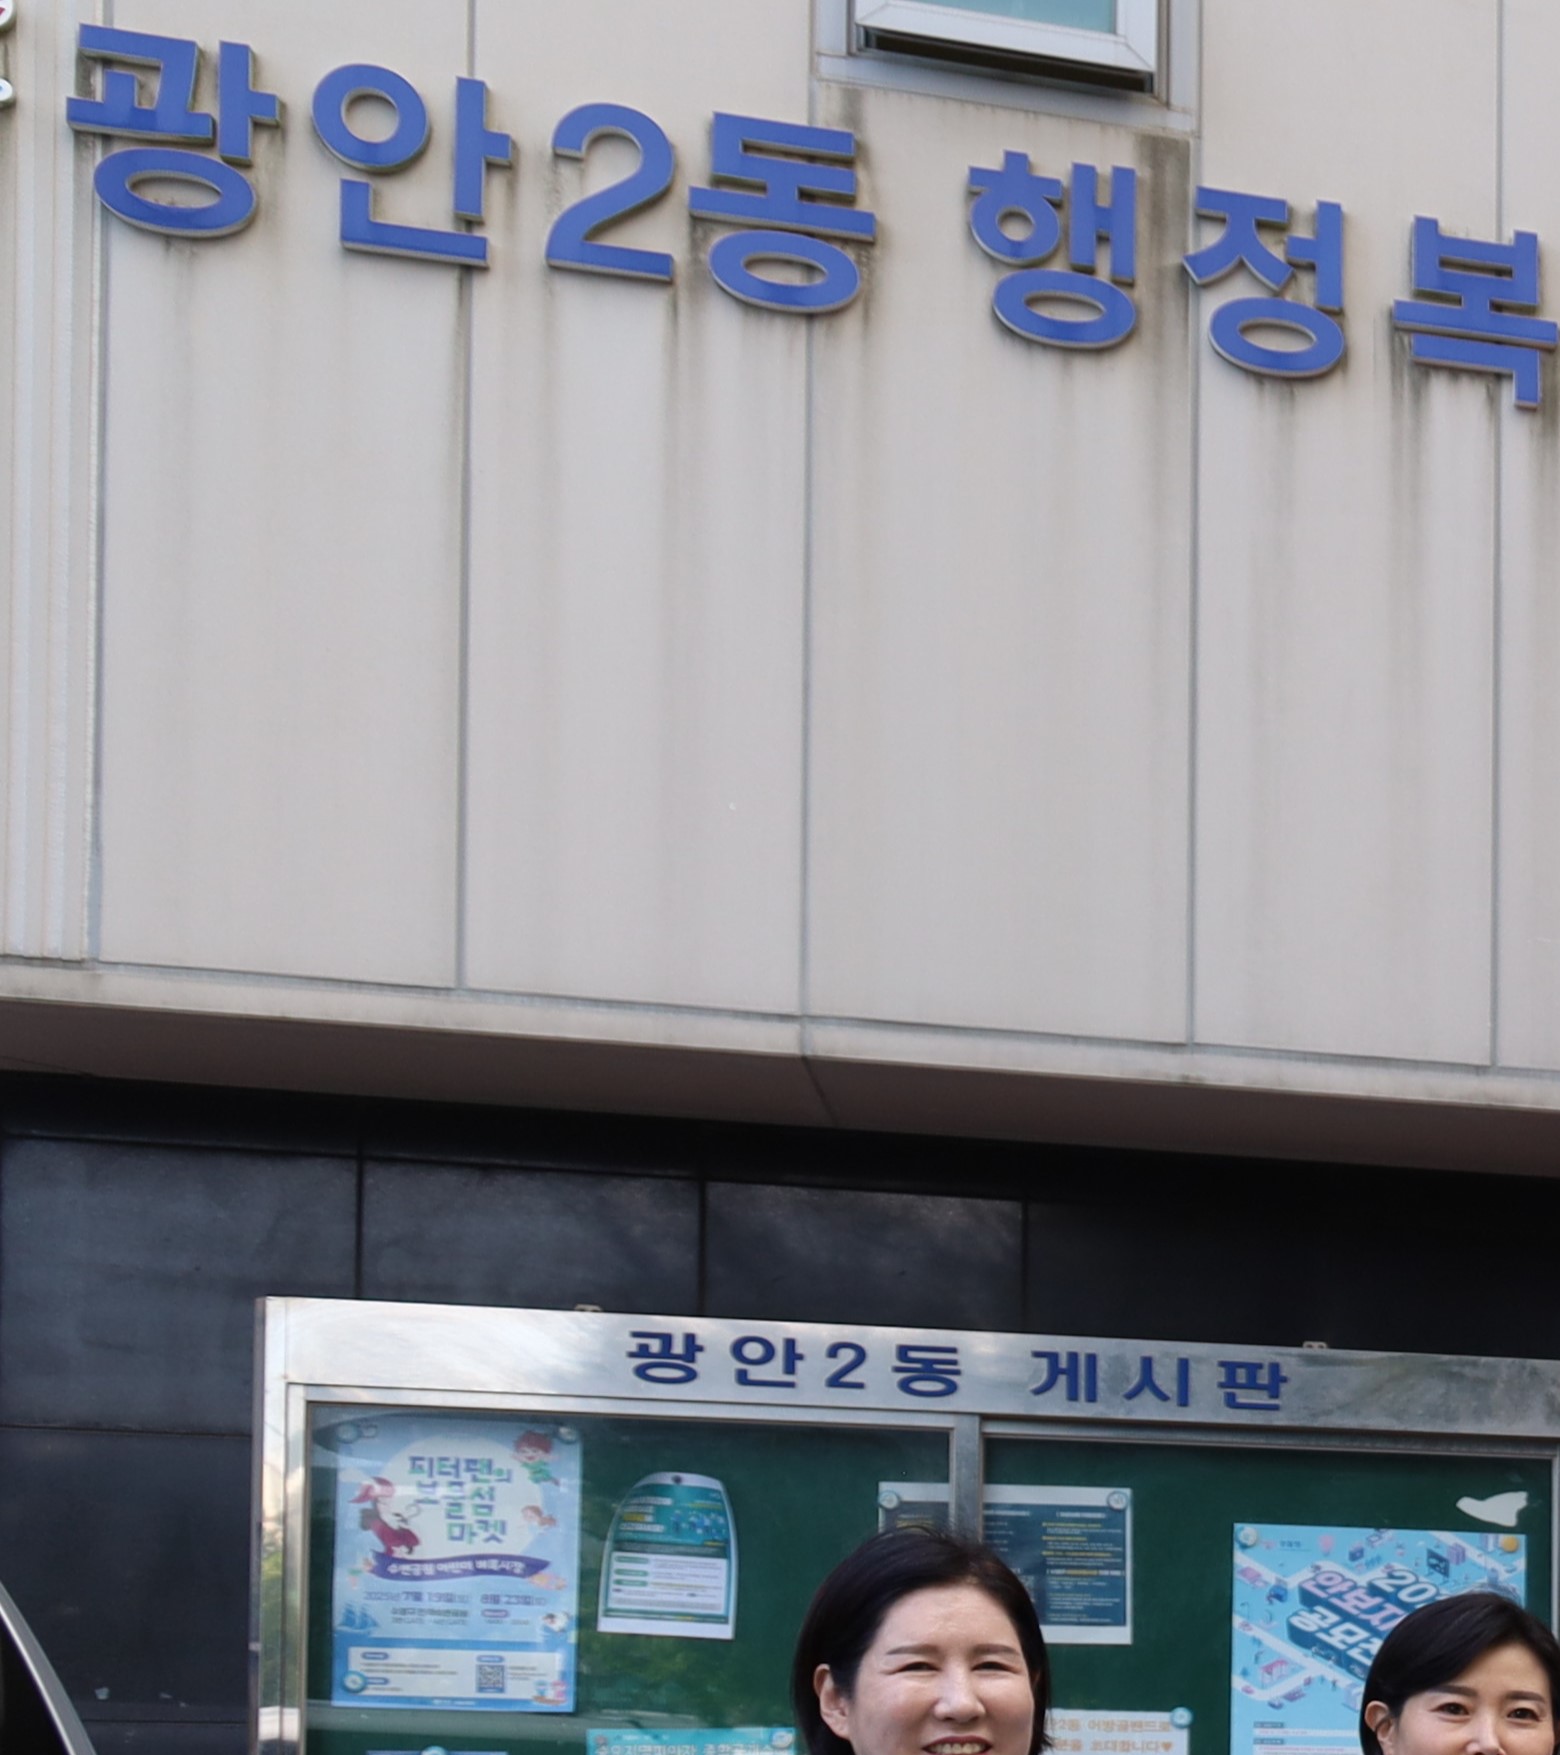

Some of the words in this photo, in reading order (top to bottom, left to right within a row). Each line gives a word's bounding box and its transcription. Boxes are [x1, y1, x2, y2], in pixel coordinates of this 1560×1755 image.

[65, 22, 877, 315] 광안2동
[626, 1330, 961, 1399] 광안2동
[1030, 1349, 1288, 1412] 게시판
